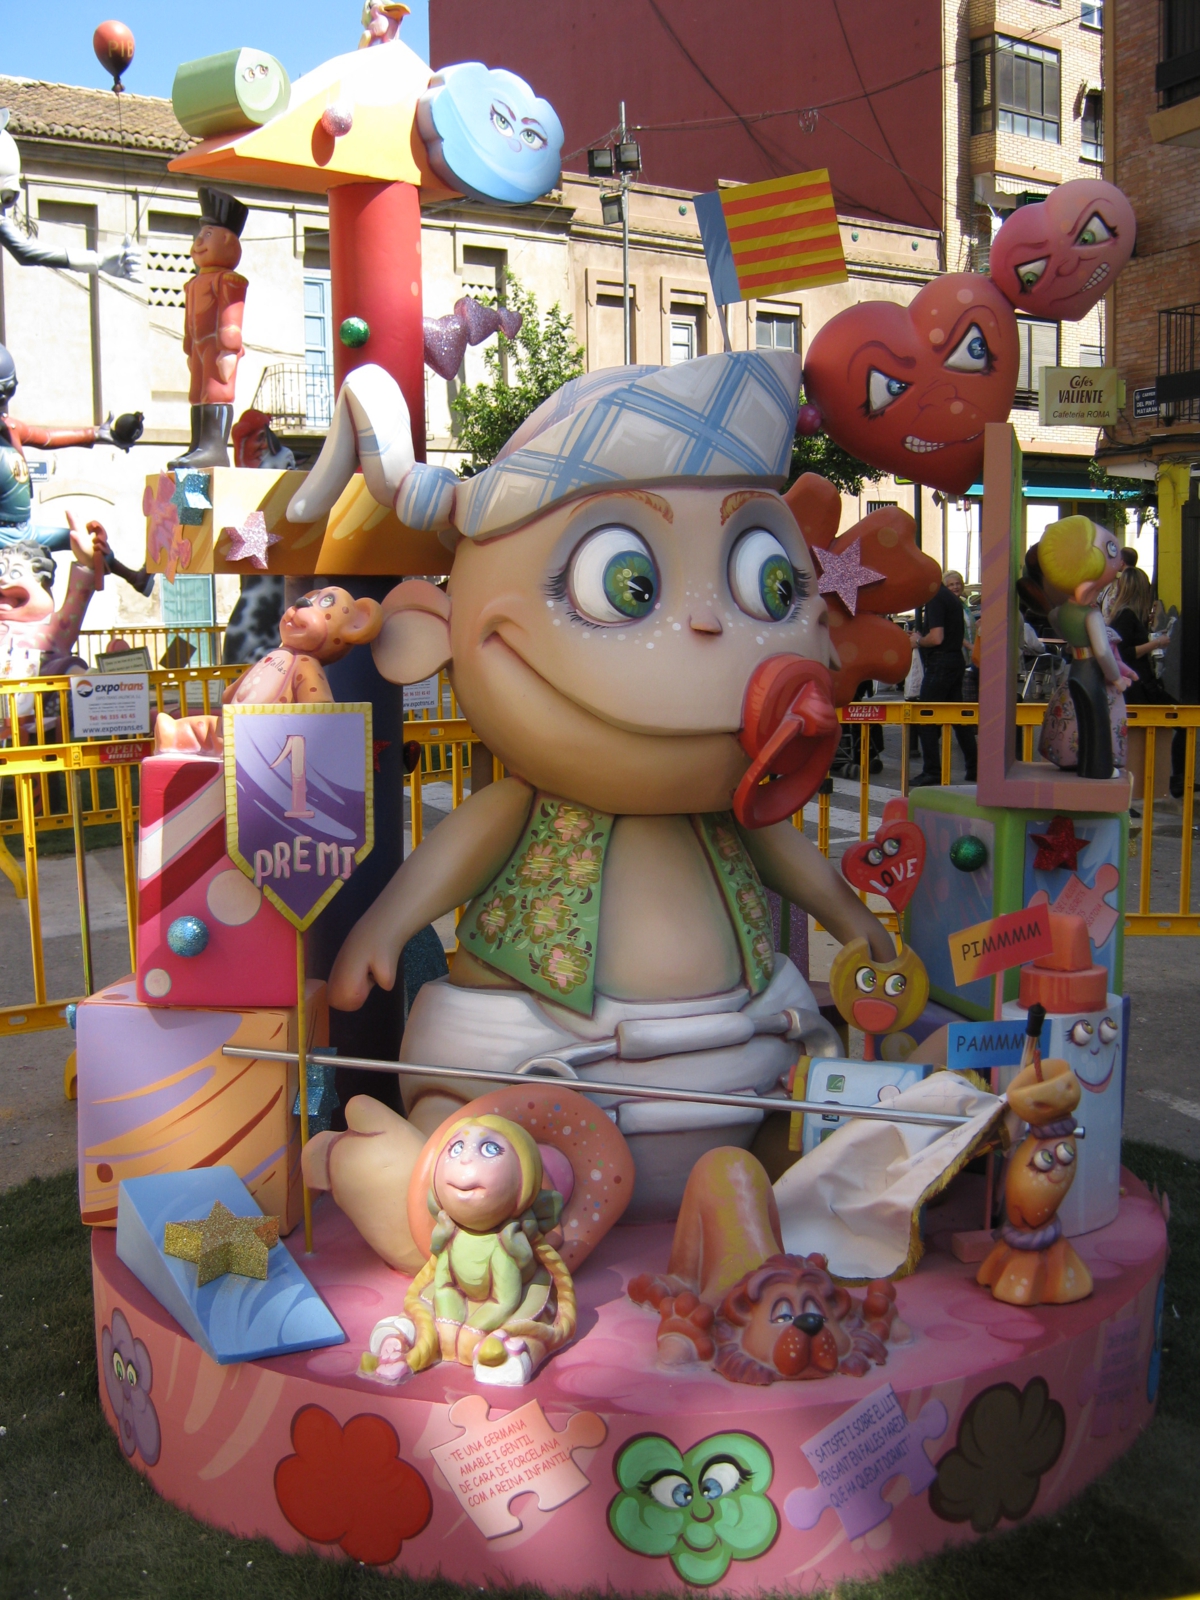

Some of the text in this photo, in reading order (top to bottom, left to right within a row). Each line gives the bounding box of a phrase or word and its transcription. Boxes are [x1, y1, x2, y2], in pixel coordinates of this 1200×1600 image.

[1058, 389, 1103, 404] VALIENTE
[1070, 375, 1094, 389] Cafés
[1086, 410, 1110, 418] ROMA
[262, 657, 287, 675] fallas
[94, 682, 144, 694] expotrans
[82, 724, 143, 733] www.expotrans.es
[106, 743, 144, 755] OPEIN
[269, 735, 315, 819] 1
[253, 835, 356, 887] PREMI
[869, 858, 918, 893] LOVE
[961, 921, 1042, 961] PIMMMM
[956, 1034, 1041, 1053] PAMMM
[852, 1409, 876, 1436] SOBRE
[872, 1404, 885, 1420] EL
[881, 1391, 899, 1414] LLIT
[466, 1440, 484, 1456] UNA
[483, 1419, 527, 1447] GERMANA
[458, 1438, 560, 1494] DE CARA DE PORCELANA
[459, 1434, 534, 1477] AMABLE I GENTIL
[818, 1456, 852, 1488] PENSANT
[848, 1447, 861, 1467] EN
[858, 1431, 885, 1460] FALLES
[467, 1490, 488, 1507] COM
[489, 1486, 496, 1498] A
[494, 1474, 525, 1495] REINA
[830, 1486, 848, 1509] QUE
[844, 1479, 858, 1499] HA
[855, 1456, 885, 1490] QUEDAT
